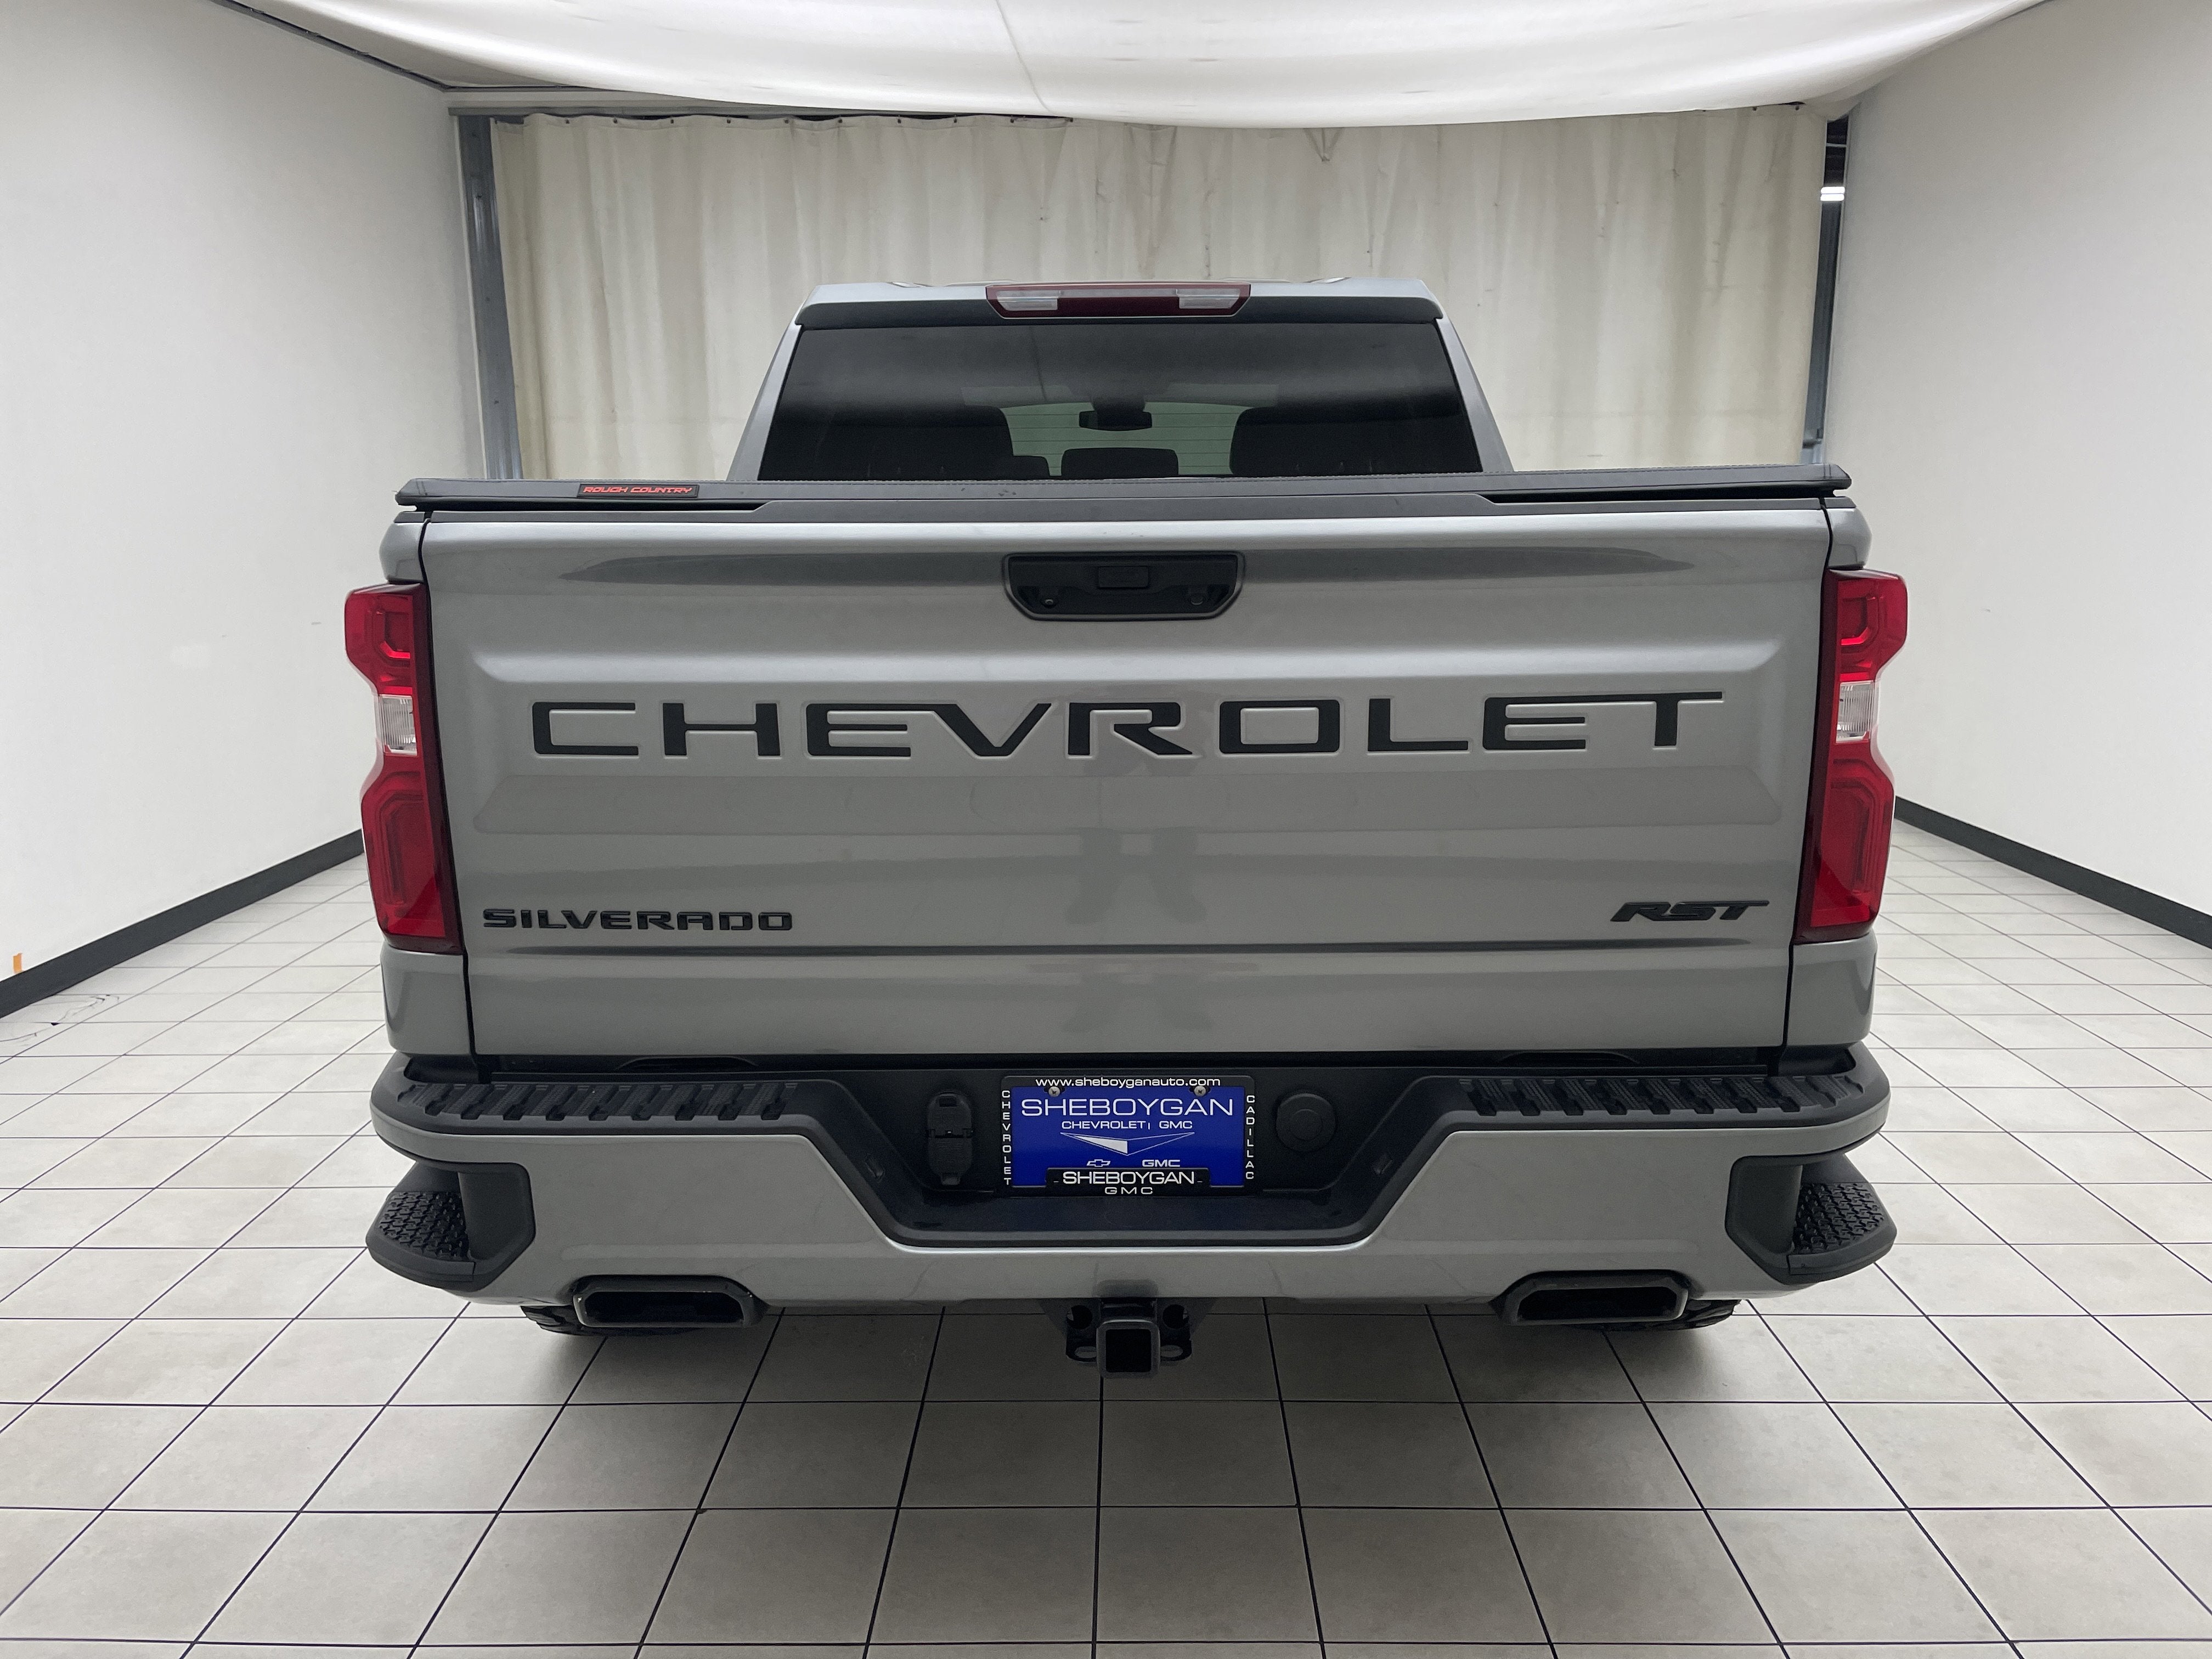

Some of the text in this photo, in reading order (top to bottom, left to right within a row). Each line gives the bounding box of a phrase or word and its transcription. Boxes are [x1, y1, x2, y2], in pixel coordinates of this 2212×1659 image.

[531, 691, 1723, 758] CHEVROLET
[482, 907, 794, 932] SILVERADO
[1609, 900, 1771, 923] RST
[1035, 1077, 1221, 1088] www.sheboyganauto.com
[1021, 1098, 1234, 1117] SHEBOYGAN
[1061, 1120, 1193, 1130] CHEVROLET GMC
[1001, 1090, 1013, 1186] CHEVROLET
[1245, 1094, 1256, 1180] CADILLAC
[1141, 1159, 1181, 1168] GMC
[1062, 1171, 1195, 1185] SHEBOYGAN
[1104, 1186, 1154, 1195] GMC
